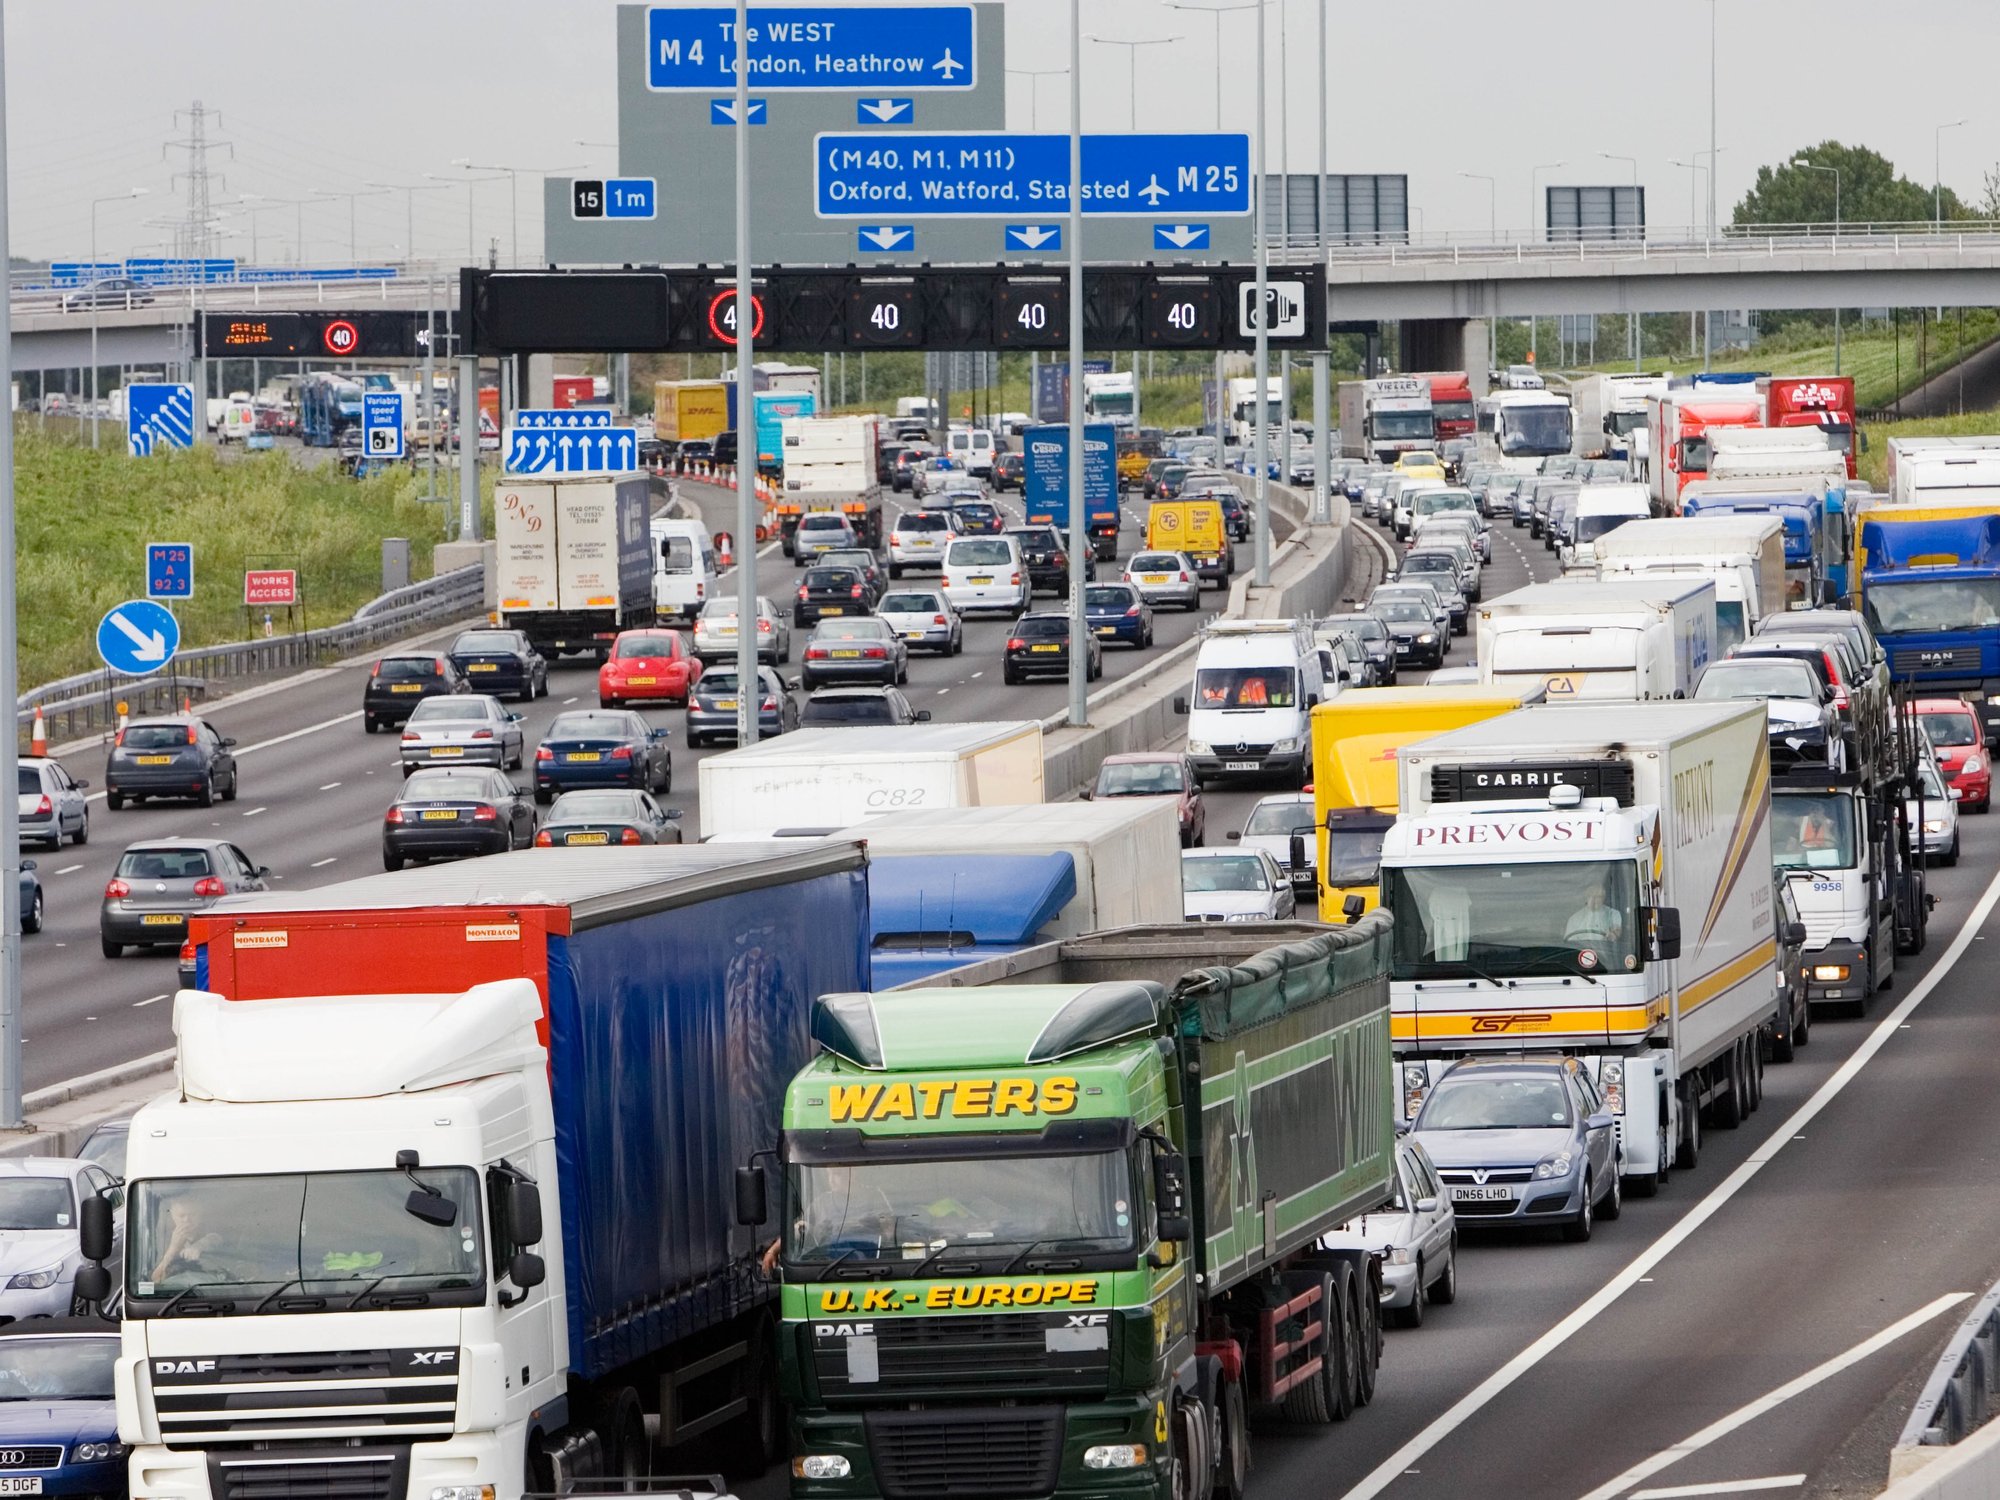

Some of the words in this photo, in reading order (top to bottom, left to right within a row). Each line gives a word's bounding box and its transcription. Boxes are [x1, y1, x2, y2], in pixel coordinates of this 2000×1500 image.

[768, 23, 835, 42] WEST
[814, 54, 924, 73] Heathrow
[828, 180, 912, 202] Oxford,
[922, 180, 1020, 201] Watford,
[1028, 180, 1130, 199] Stasted
[579, 192, 598, 208] 15
[870, 303, 899, 329] 40
[1017, 303, 1046, 329] 40
[1166, 303, 1196, 329] 40
[332, 329, 351, 346] 40
[366, 397, 400, 405] Variable
[371, 406, 395, 415] speed
[165, 564, 175, 576] A
[252, 576, 290, 586] WORKS
[249, 588, 291, 598] ACCESS
[1920, 652, 1953, 661] MAN
[866, 788, 926, 807] C82
[1412, 820, 1604, 847] PREVOST
[1813, 882, 1842, 892] 9958
[235, 935, 287, 945] MONTRACON
[467, 928, 519, 938] MONTRACON
[829, 1076, 1080, 1123] WATERS
[1455, 1189, 1484, 1200] DN56
[1485, 1188, 1508, 1199] LHO
[925, 1279, 1100, 1309] EUROPE
[1063, 1314, 1110, 1329] XF
[815, 1323, 875, 1338] DAF
[408, 1351, 456, 1366] XF
[155, 1360, 217, 1376] DAF
[13, 1478, 39, 1491] DGF
